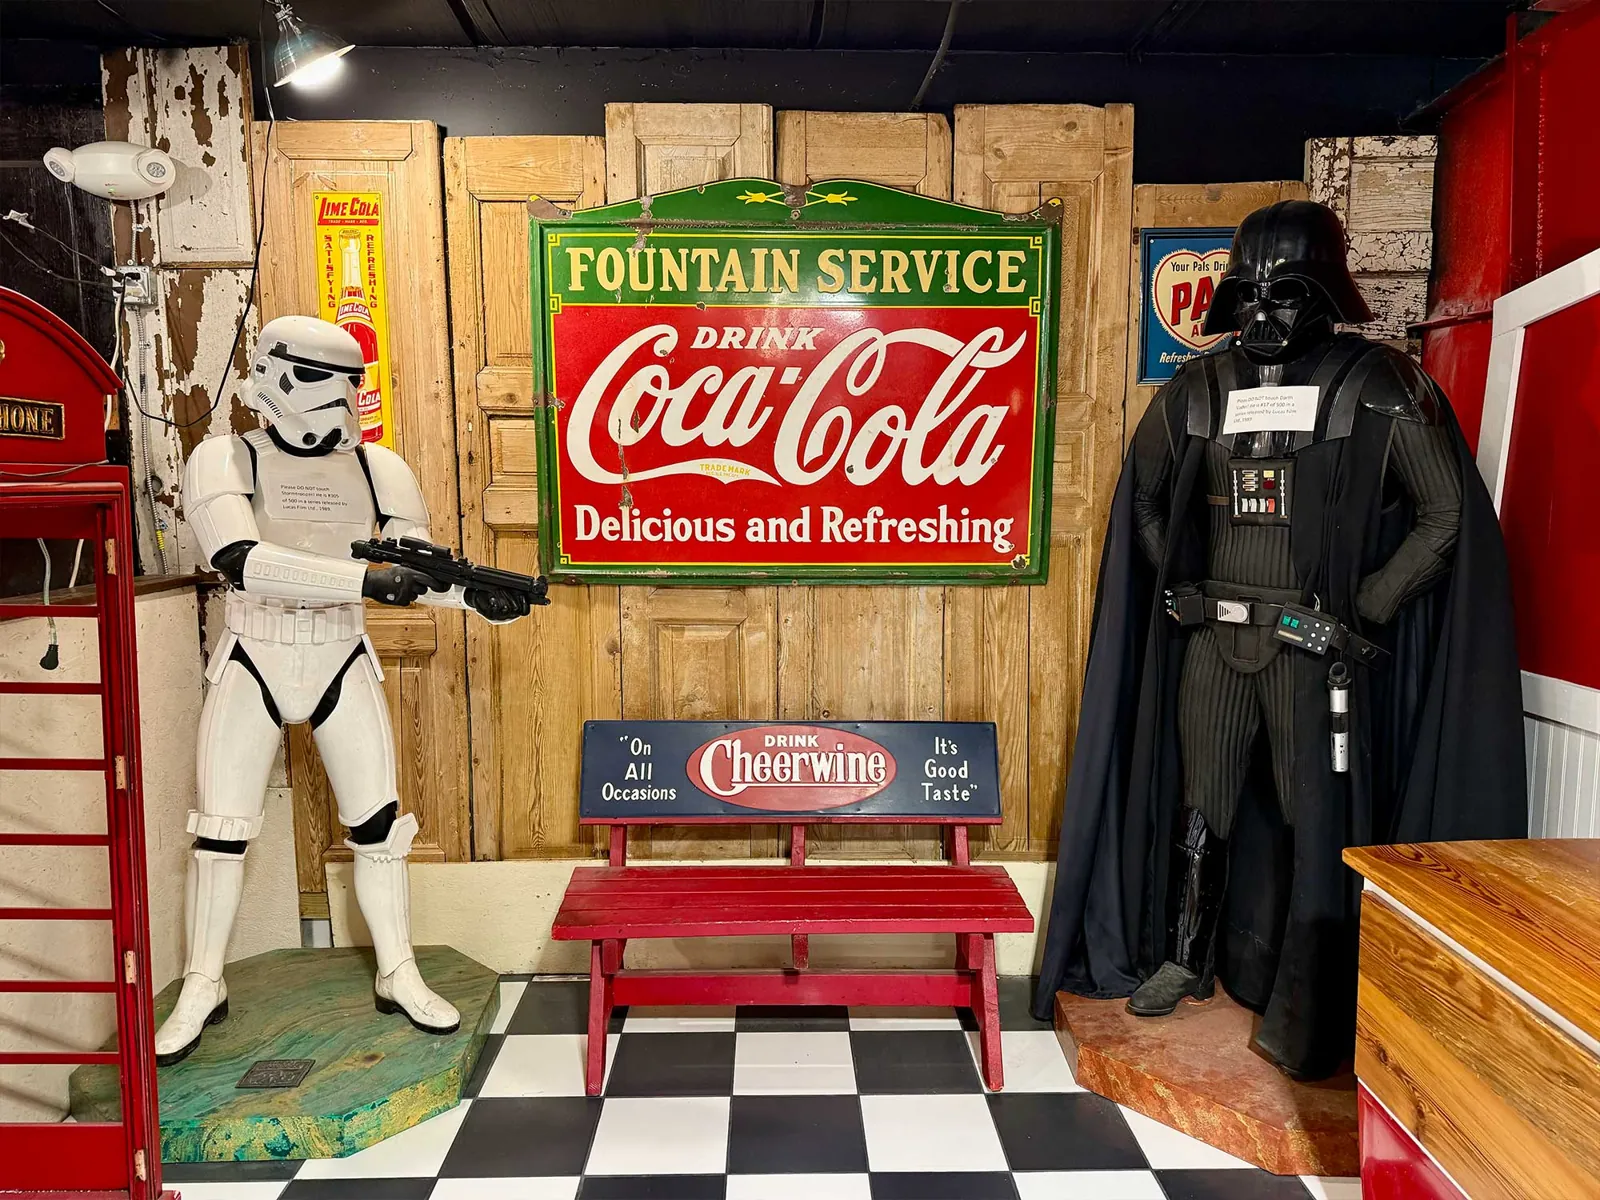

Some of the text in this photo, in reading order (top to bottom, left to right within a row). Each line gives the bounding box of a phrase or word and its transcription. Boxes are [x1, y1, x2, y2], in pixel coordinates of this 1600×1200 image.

[317, 197, 379, 226] LIME COLA
[324, 234, 336, 308] SATISFYING
[366, 234, 378, 308] REFRESHING
[565, 247, 1027, 293] FOUNTAIN SERVICE
[1171, 261, 1190, 272] Your
[1193, 261, 1210, 272] Pals
[353, 302, 370, 316] COLA
[1170, 273, 1226, 326] PA
[690, 326, 826, 351] DRINK
[358, 390, 381, 406] COLA
[566, 324, 1027, 487] Coca-Cola
[700, 463, 726, 471] TRADE
[728, 464, 751, 476] MARK
[574, 504, 1014, 553] Delicious and Refreshing
[764, 734, 819, 748] DRINK
[934, 737, 958, 755] It's
[624, 763, 652, 780] All
[699, 739, 887, 796] Cheerwine
[924, 759, 969, 779] Good
[601, 782, 677, 801] Occasions
